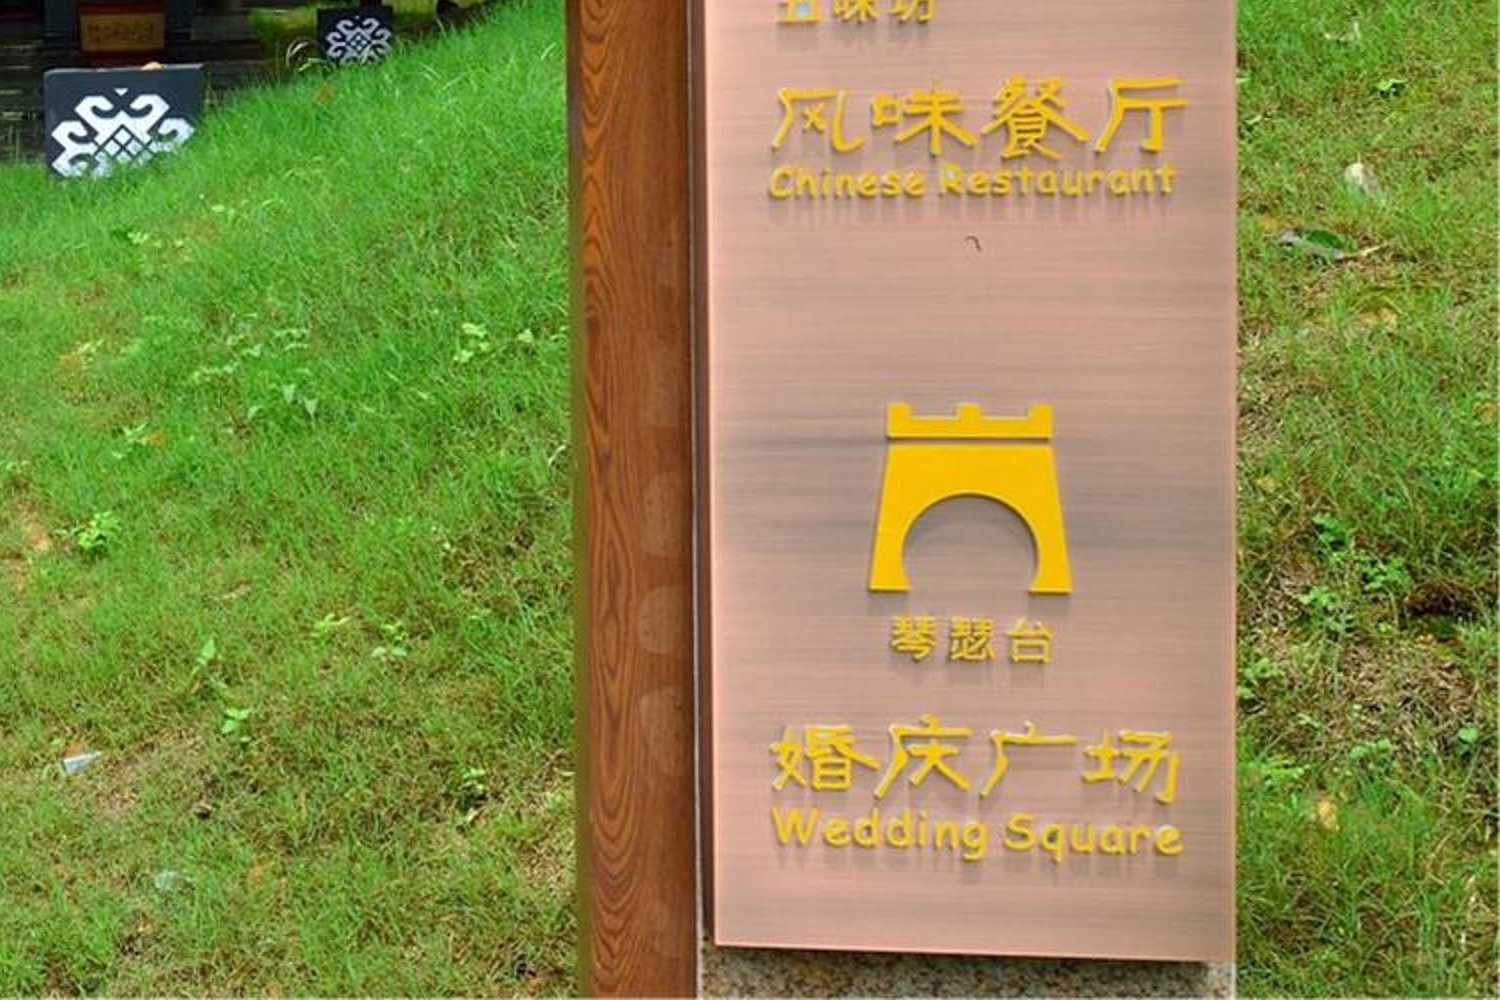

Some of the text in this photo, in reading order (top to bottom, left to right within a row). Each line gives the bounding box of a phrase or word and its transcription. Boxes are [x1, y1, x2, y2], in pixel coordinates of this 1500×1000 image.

[770, 74, 1189, 161] 风味餐厅
[769, 162, 1178, 199] Chinese Restaurant
[890, 615, 1054, 664] 琴瑟台
[770, 713, 1184, 805] 婚庆广场
[770, 807, 1185, 863] Wedding Square
